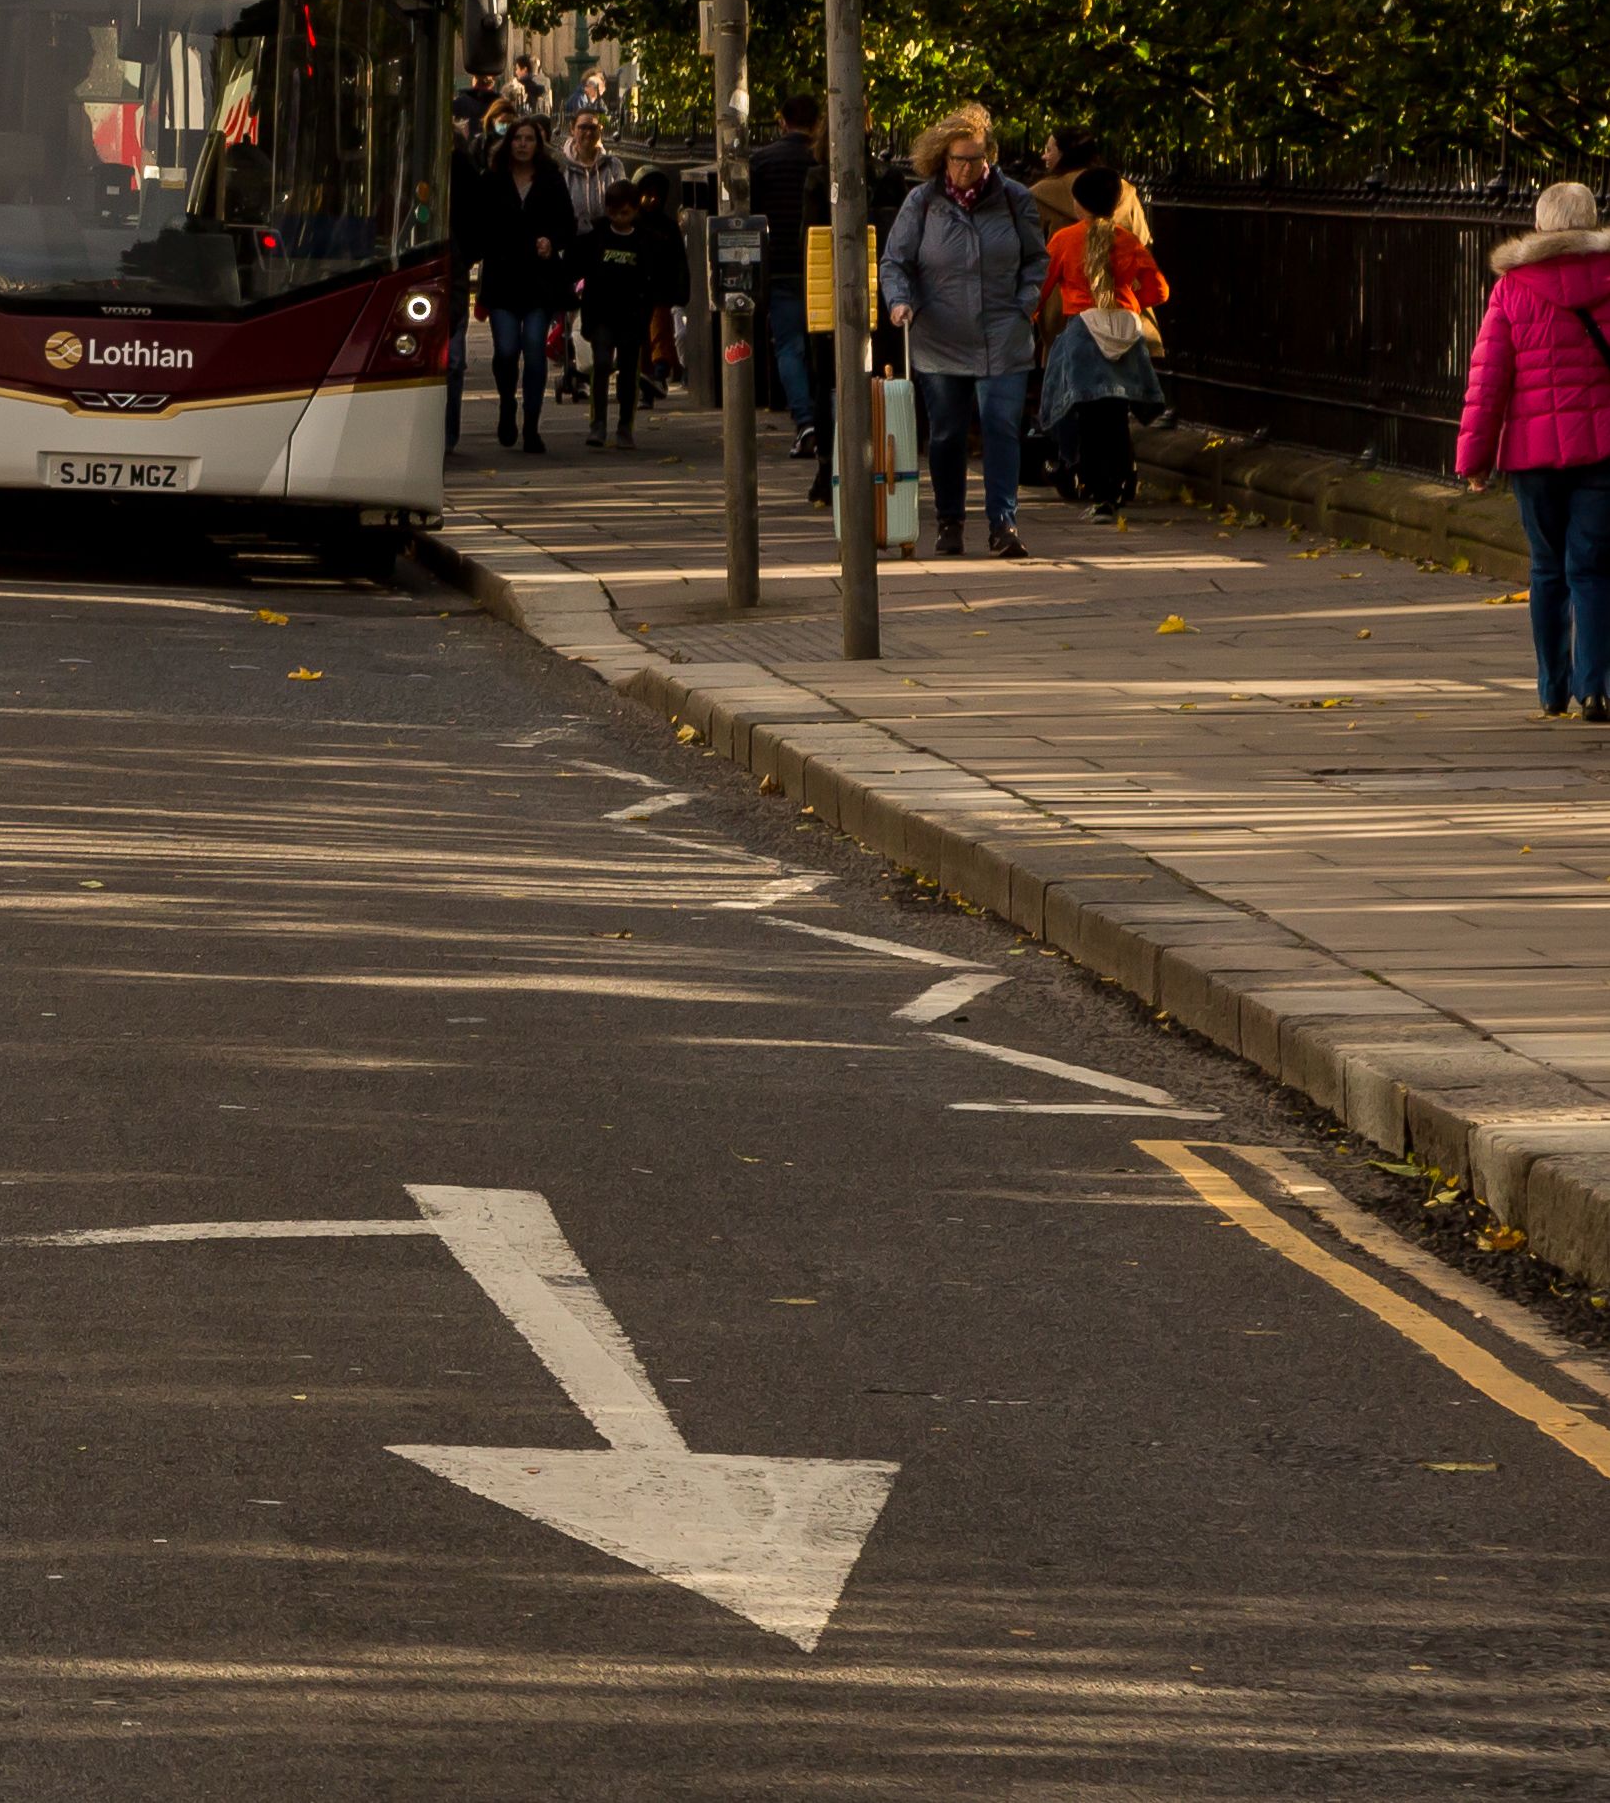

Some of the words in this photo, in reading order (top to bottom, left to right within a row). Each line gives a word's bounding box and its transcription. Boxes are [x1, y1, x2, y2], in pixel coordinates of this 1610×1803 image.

[101, 306, 152, 316] VOLVO
[88, 339, 193, 369] Lothian
[60, 462, 123, 486] SJ67
[130, 464, 177, 487] MGZ
